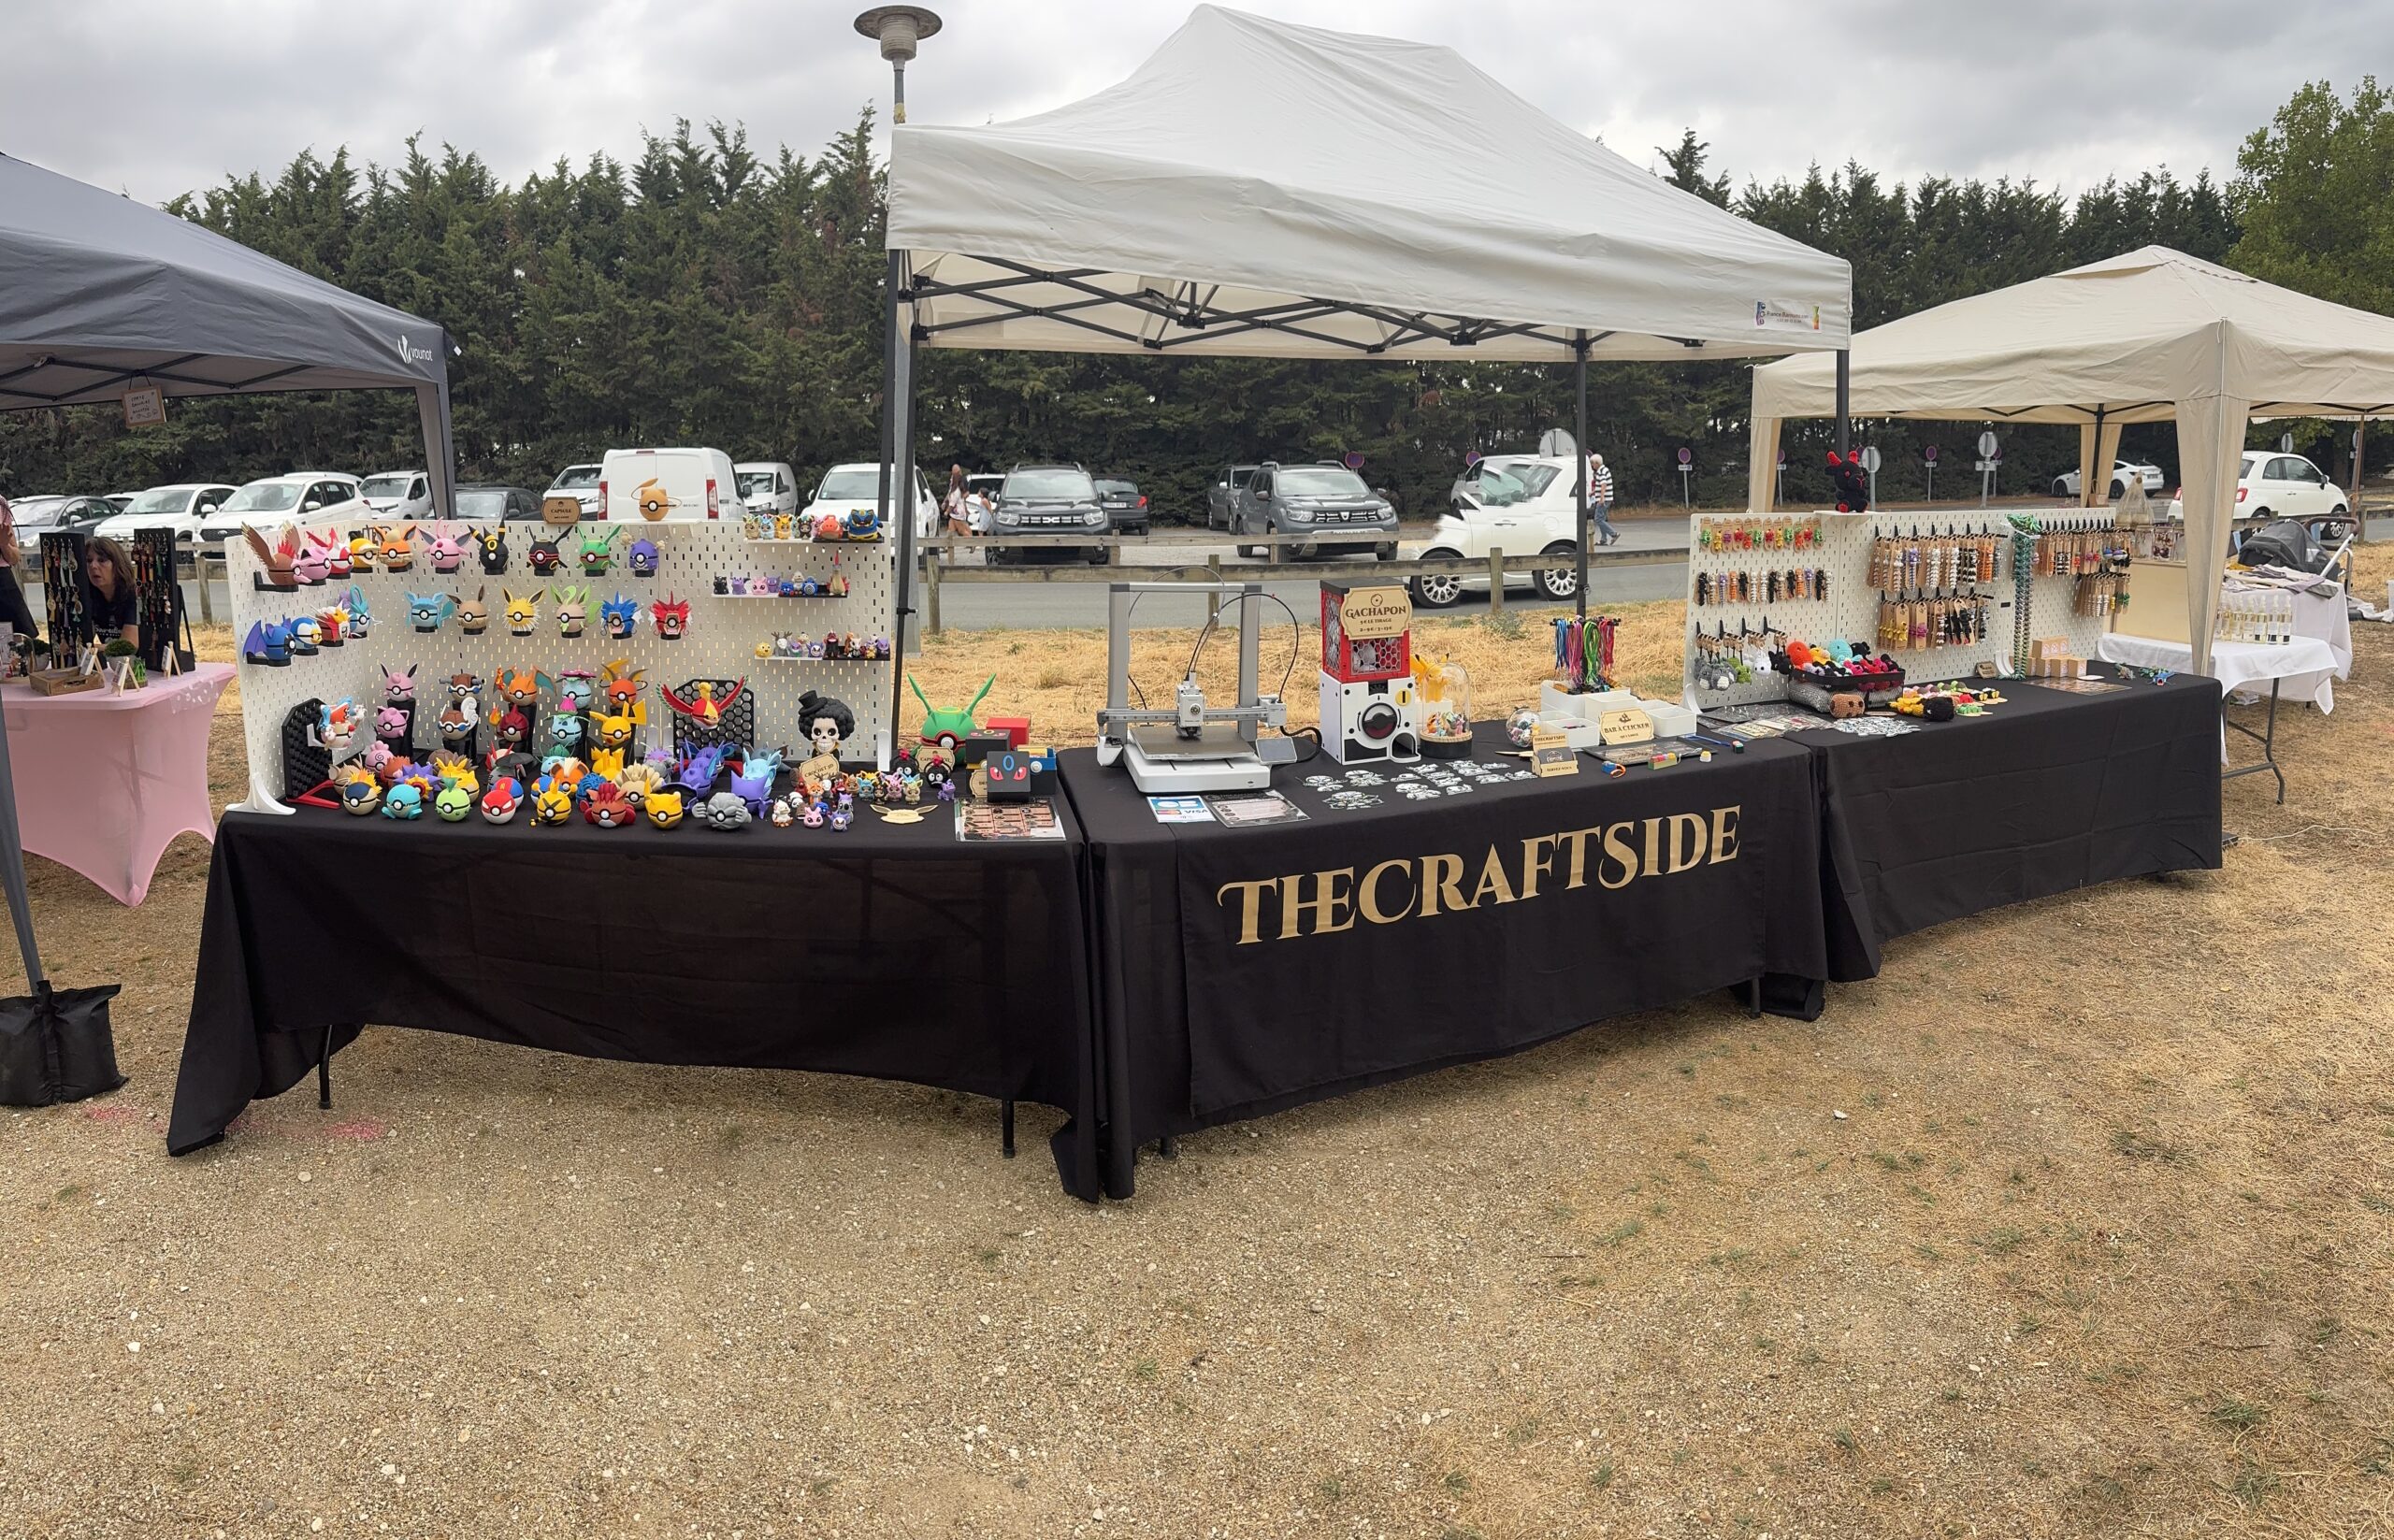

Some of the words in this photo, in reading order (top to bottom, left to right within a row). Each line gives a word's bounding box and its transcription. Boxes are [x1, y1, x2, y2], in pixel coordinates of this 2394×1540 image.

[411, 347, 433, 362] vounot
[1346, 606, 1406, 620] GACHAPON
[1622, 722, 1650, 731] CLICKER
[804, 765, 828, 778] CROCHET
[1216, 804, 1741, 945] THECRAFTSIDE
